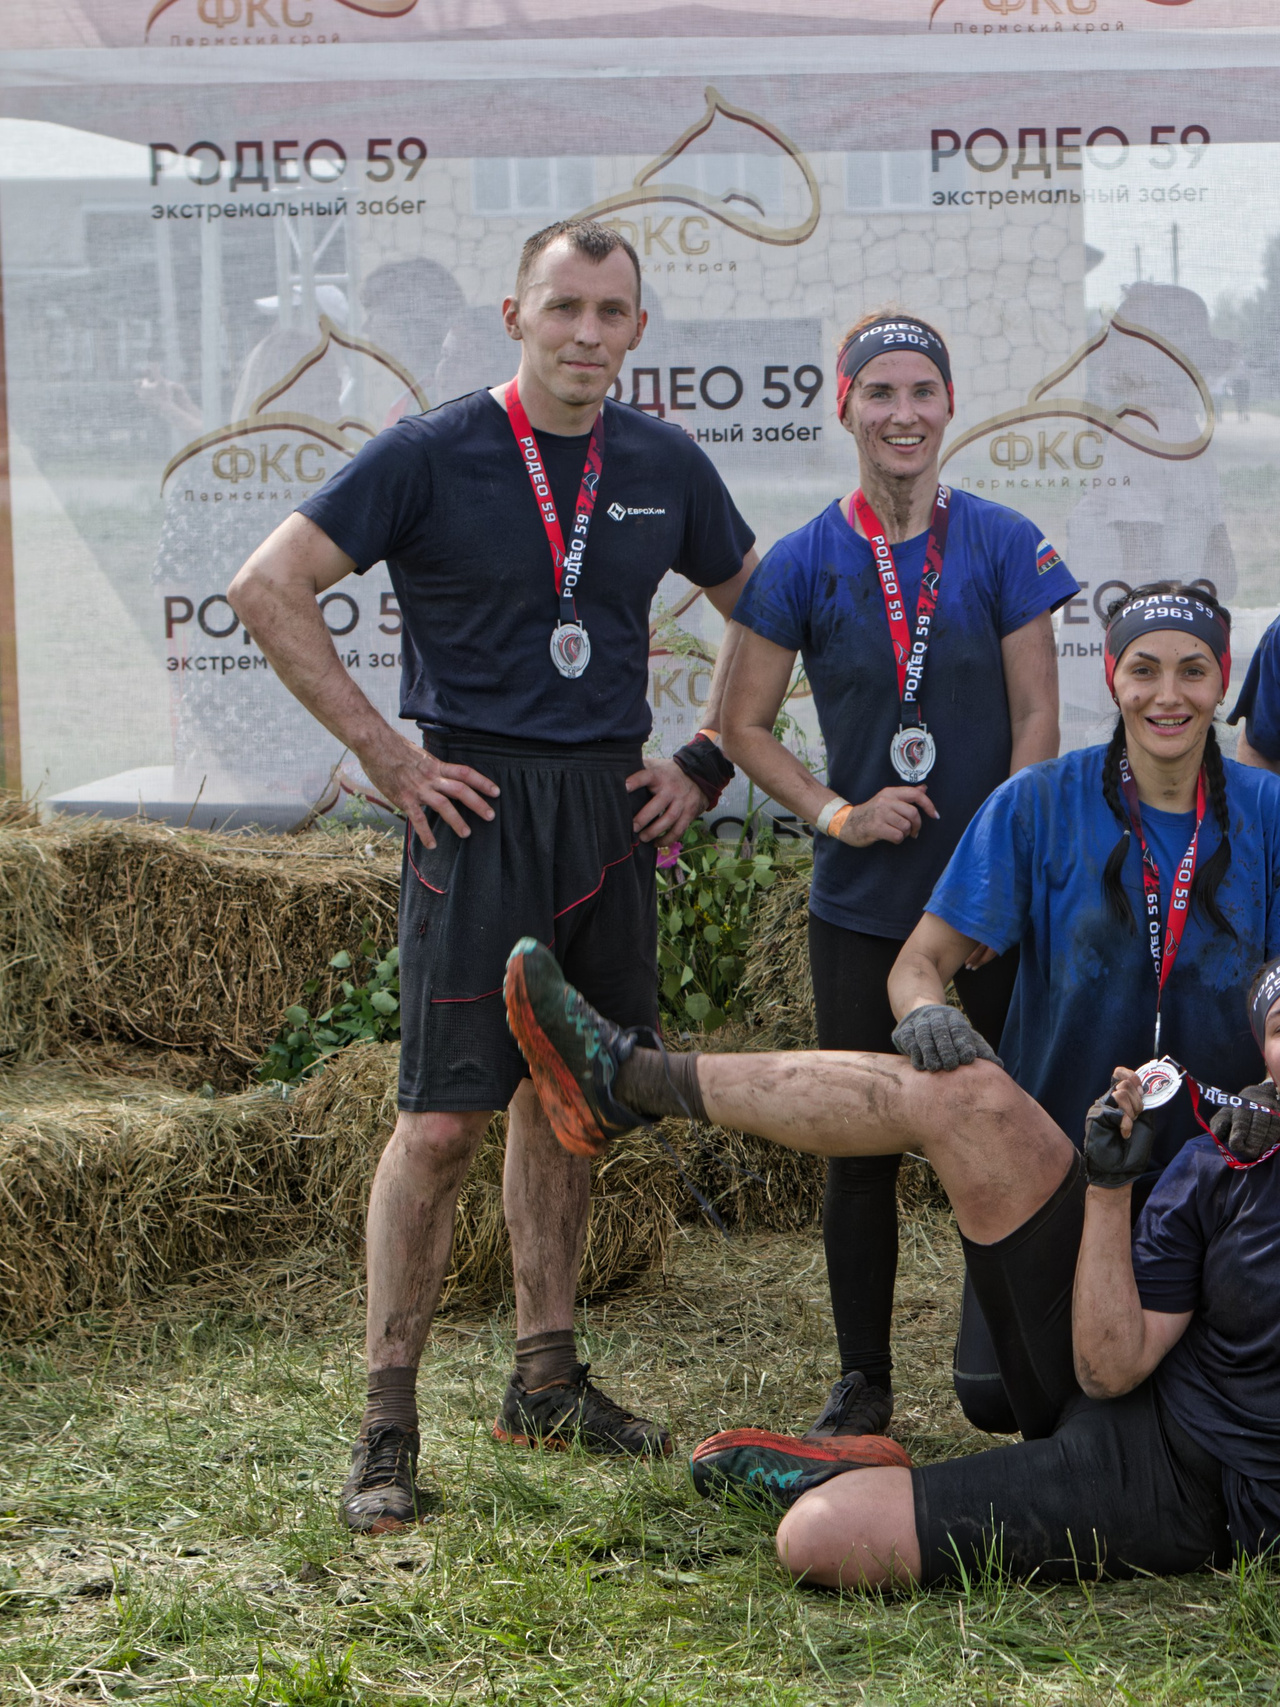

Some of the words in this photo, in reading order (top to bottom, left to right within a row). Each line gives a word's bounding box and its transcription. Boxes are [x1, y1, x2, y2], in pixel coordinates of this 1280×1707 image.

[170, 33, 279, 47] Пермский
[289, 32, 341, 46] край
[954, 21, 1063, 36] Пермский
[1072, 20, 1125, 34] край
[931, 125, 1130, 180] РОДЕО
[1148, 124, 1211, 170] 59
[150, 138, 347, 193] РОДЕО
[365, 136, 428, 183] 59
[932, 184, 1129, 210] экстремальный
[1138, 182, 1209, 203] забег
[152, 197, 348, 223] экстремальный
[356, 195, 426, 215] забег
[686, 260, 737, 275] край
[859, 323, 923, 342] РОДЕО
[883, 332, 929, 349] 2302
[614, 365, 744, 418] ДЕО
[762, 364, 823, 410] 59
[752, 422, 823, 443] забег
[989, 431, 1104, 471] ФКС
[212, 443, 326, 484] ФКС
[520, 436, 549, 498] РОДЕО
[541, 501, 556, 523] 59
[961, 476, 1070, 491] Пермский
[1080, 475, 1131, 489] край
[184, 489, 293, 504] Пермский
[563, 538, 587, 598] РОДЕО
[575, 513, 589, 536] 59
[871, 535, 899, 595] РОДЕО
[888, 600, 904, 621] 59
[1122, 594, 1189, 618] РОДЕО
[1195, 601, 1214, 618] 59
[1143, 607, 1194, 621] 2963
[164, 592, 360, 645] РОО
[904, 641, 928, 702] РОДЕО
[916, 615, 931, 636] 59
[1147, 893, 1159, 915] 59
[1174, 889, 1189, 911] 59
[1249, 1101, 1271, 1113] 59
